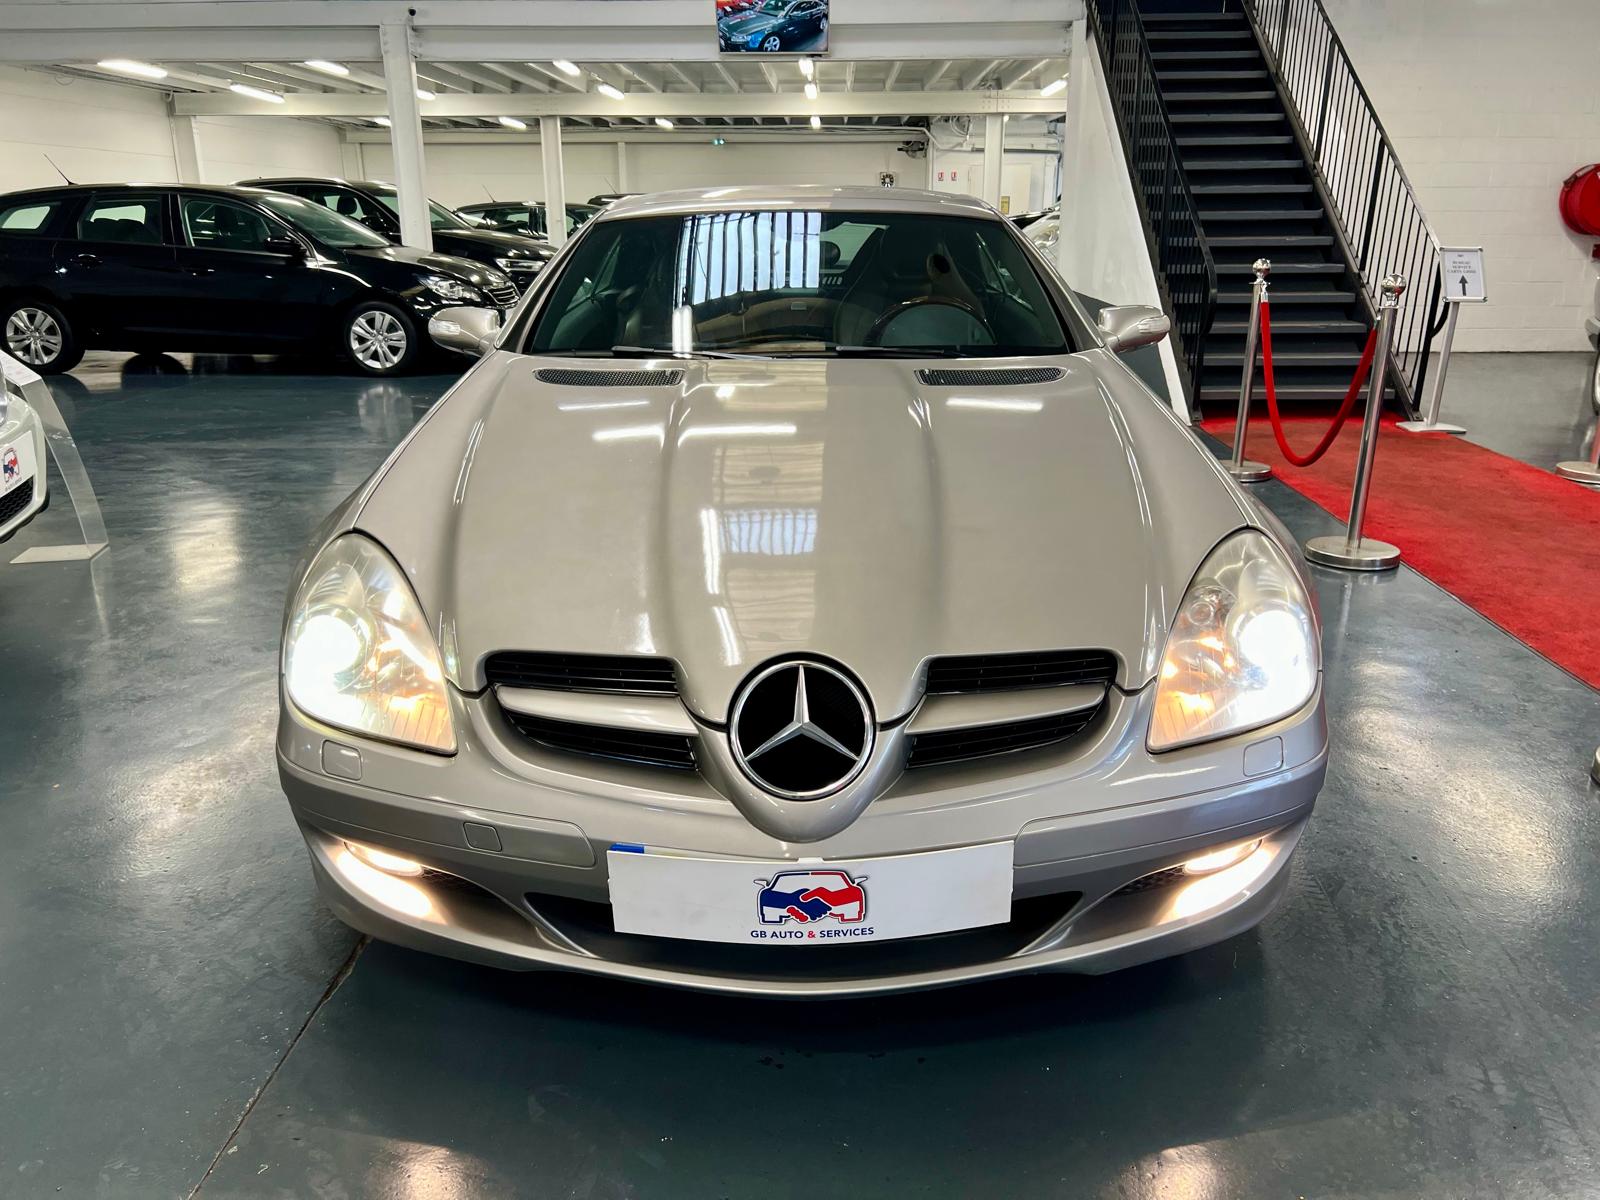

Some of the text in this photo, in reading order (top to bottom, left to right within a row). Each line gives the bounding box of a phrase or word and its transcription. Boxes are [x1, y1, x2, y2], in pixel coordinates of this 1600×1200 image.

[750, 927, 874, 939] GB AUTO & SERVICES
